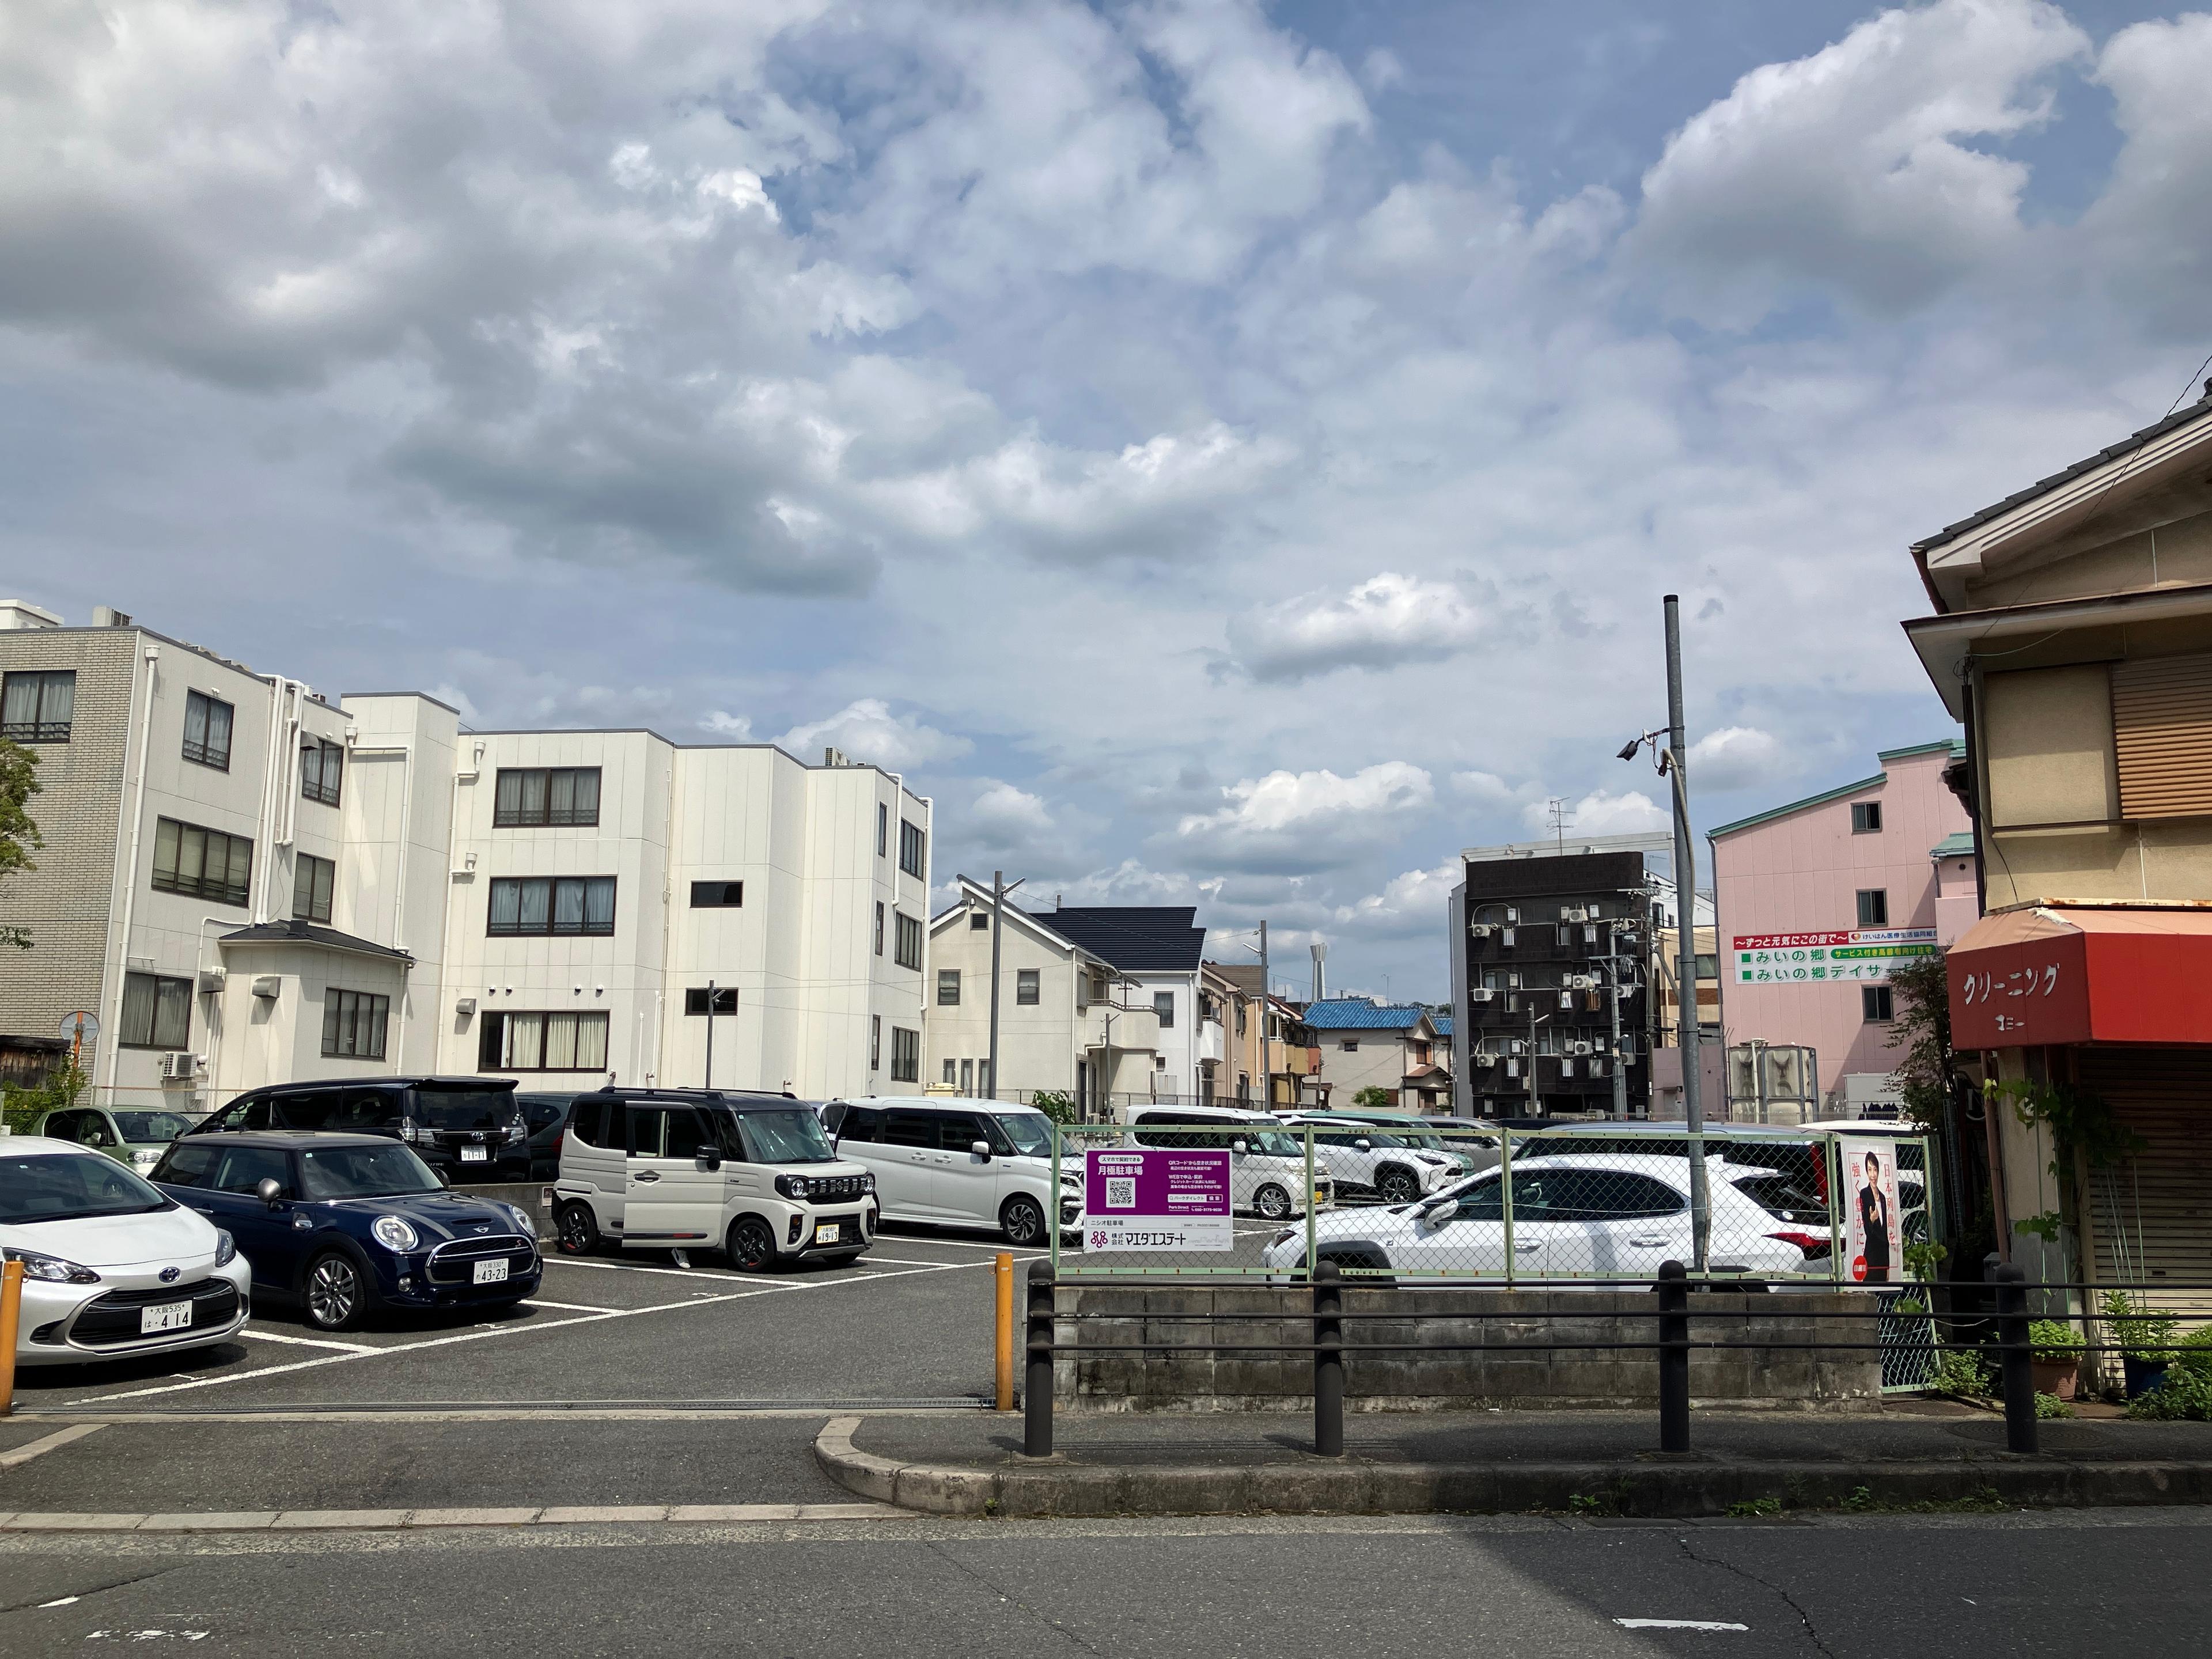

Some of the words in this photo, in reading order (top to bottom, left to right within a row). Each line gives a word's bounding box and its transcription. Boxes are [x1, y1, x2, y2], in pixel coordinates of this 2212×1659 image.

[1756, 949, 1825, 963] みいの郷
[1964, 963, 2060, 1005] クリーニング
[1098, 1166, 1143, 1175] 月極駐車場
[822, 1232, 838, 1241] 19-13
[1125, 1233, 1186, 1245] マエダエステート
[482, 1268, 506, 1281] 43-23
